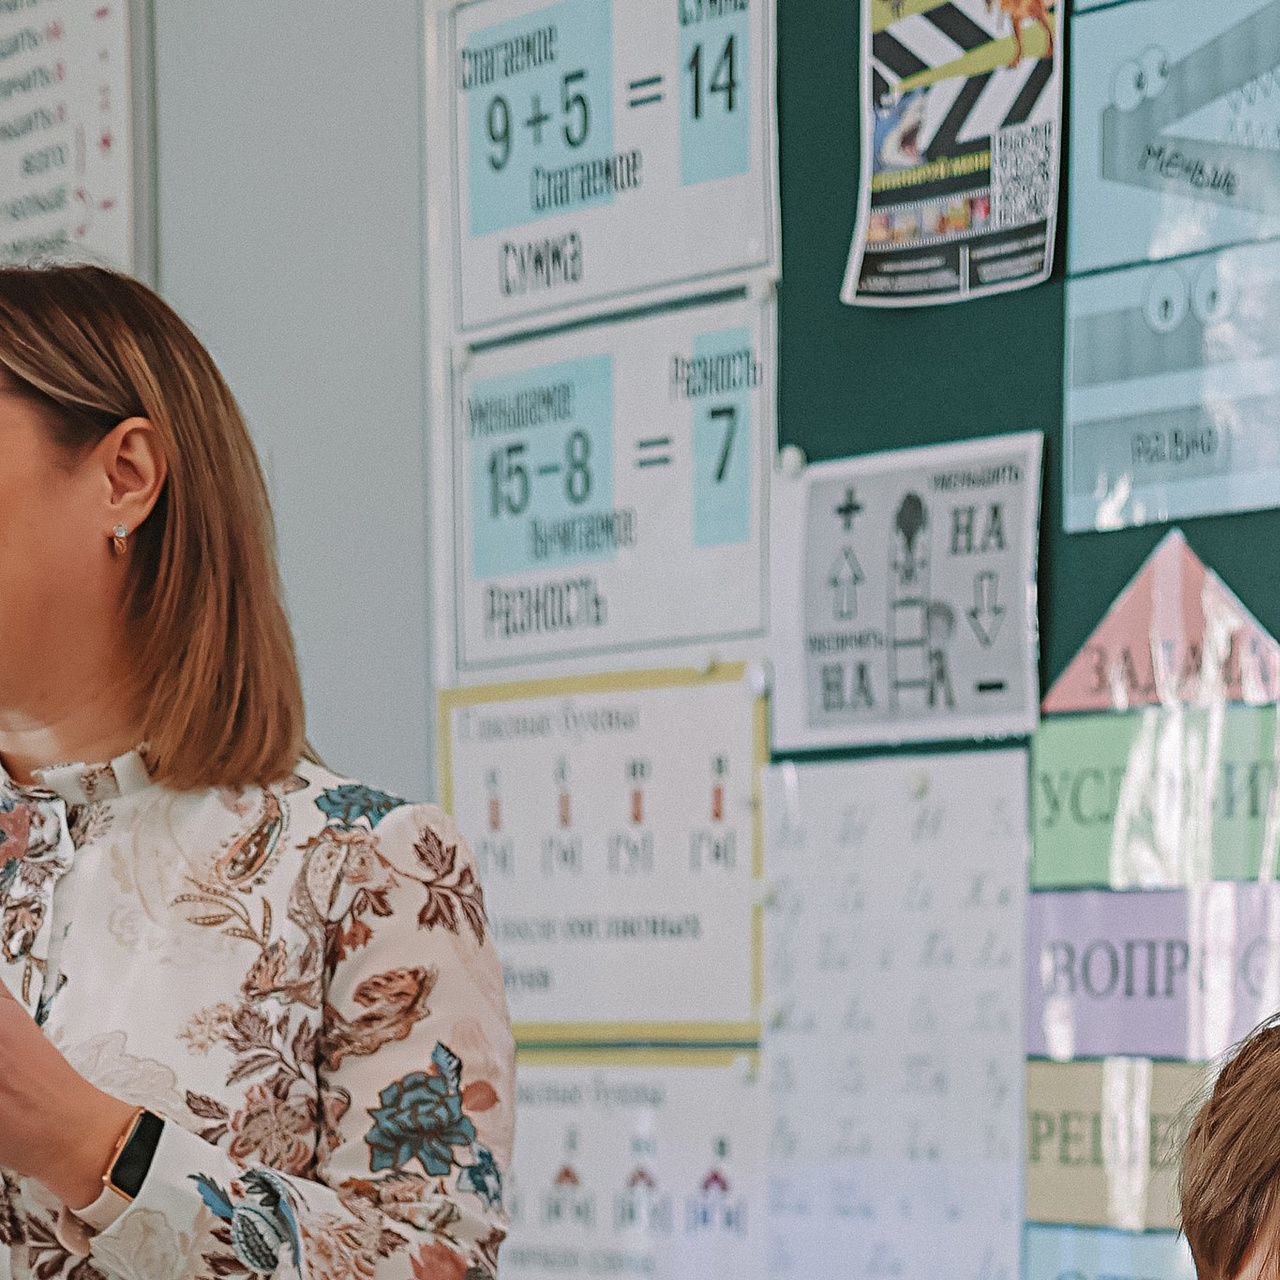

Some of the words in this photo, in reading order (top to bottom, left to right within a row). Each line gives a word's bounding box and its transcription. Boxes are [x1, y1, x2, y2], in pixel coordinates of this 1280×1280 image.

[689, 33, 735, 119] 14
[708, 405, 736, 482] 7
[950, 503, 1006, 556] НА
[1045, 934, 1275, 999] ВОПРС
